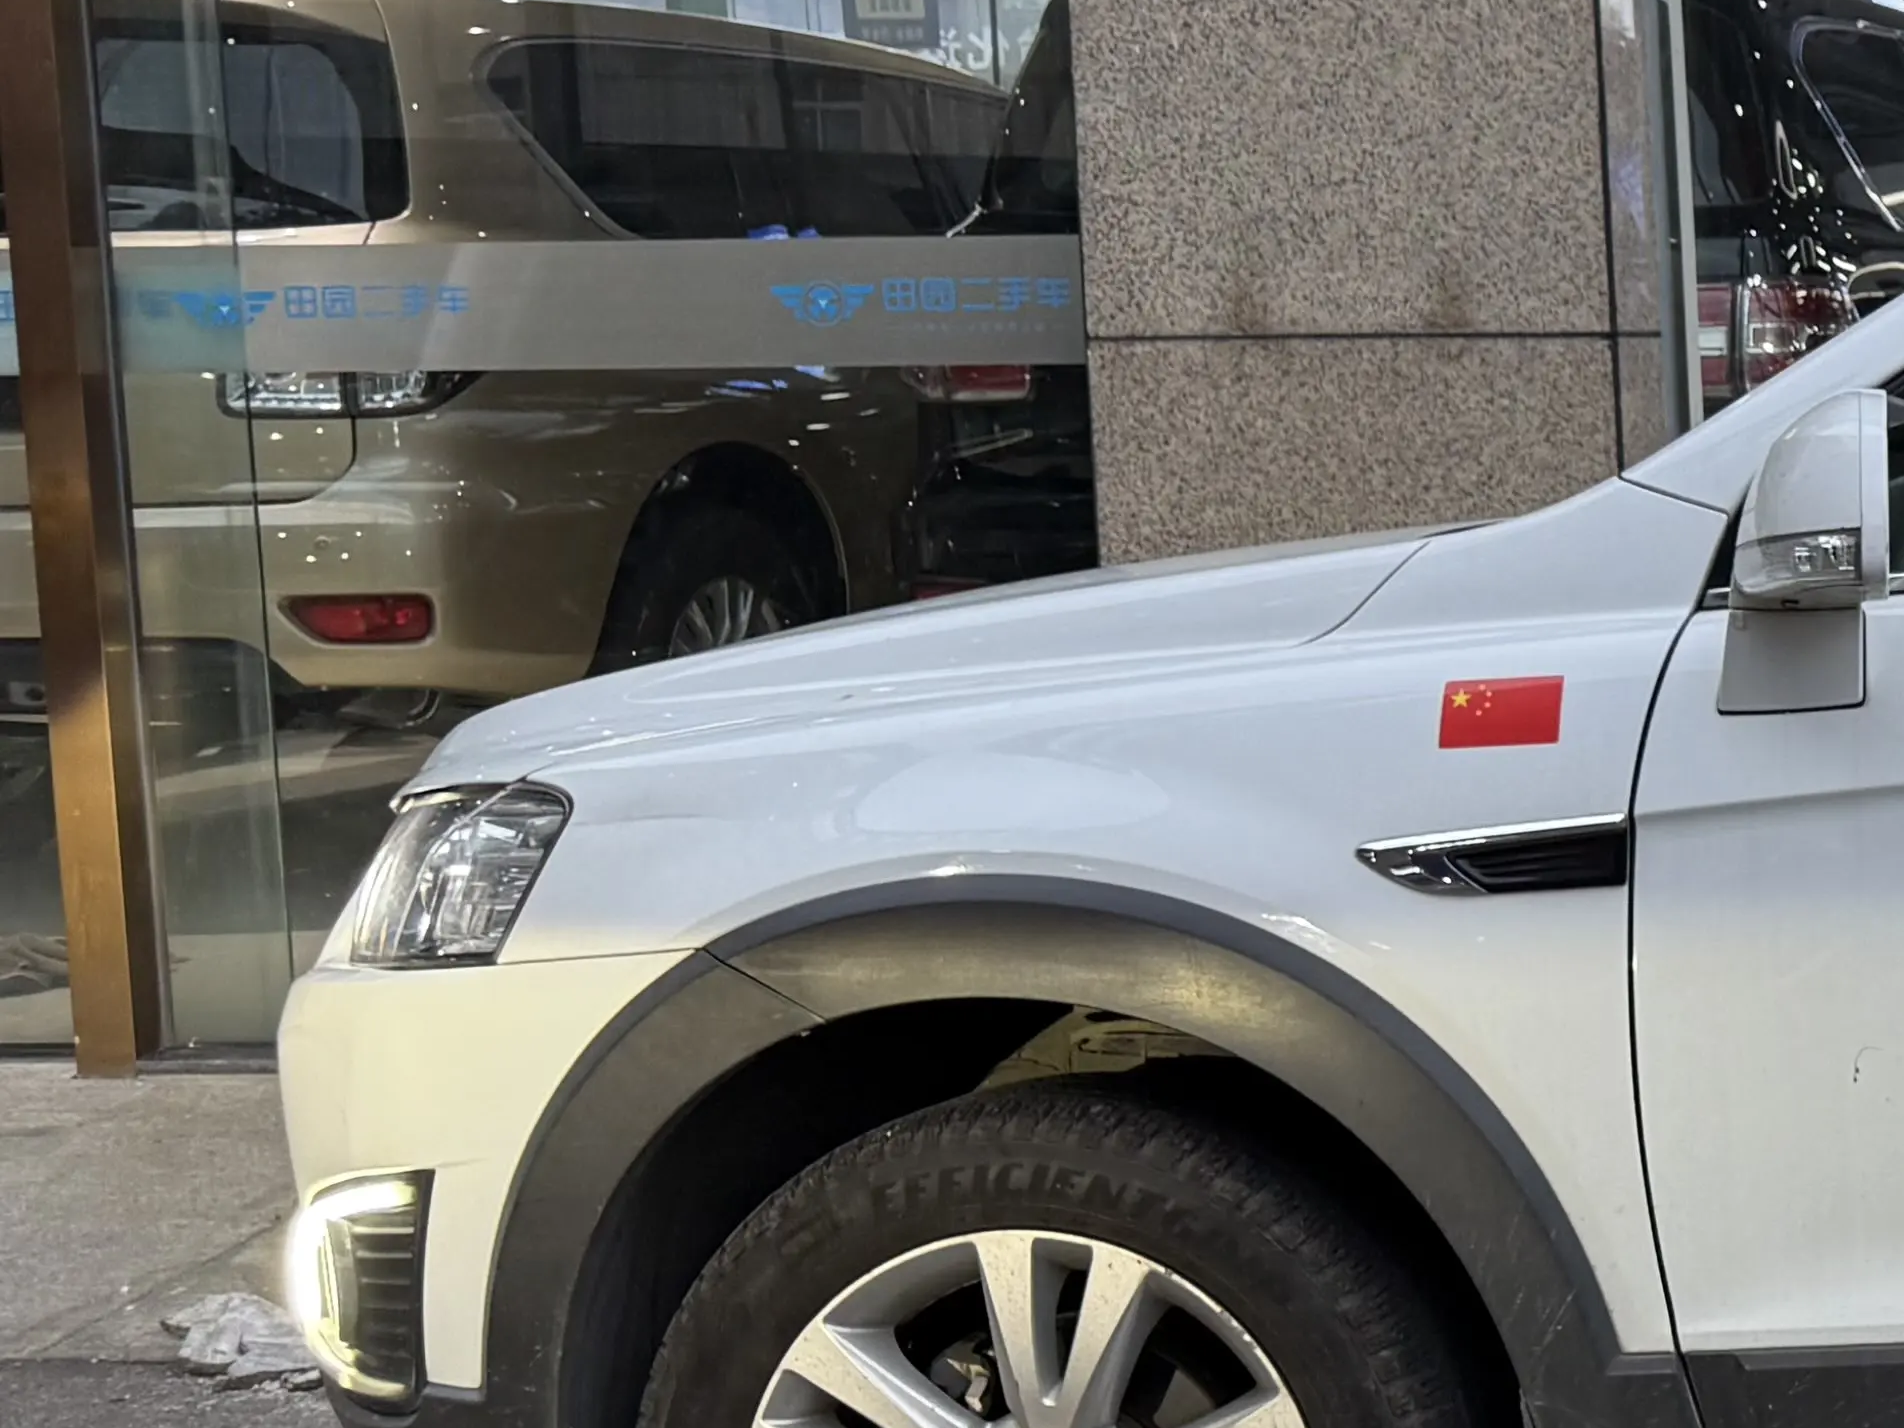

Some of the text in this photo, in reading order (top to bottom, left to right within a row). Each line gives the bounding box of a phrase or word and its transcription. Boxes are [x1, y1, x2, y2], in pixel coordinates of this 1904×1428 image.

[284, 284, 471, 318] 田园二手车
[881, 276, 1073, 313] 田园二手车
